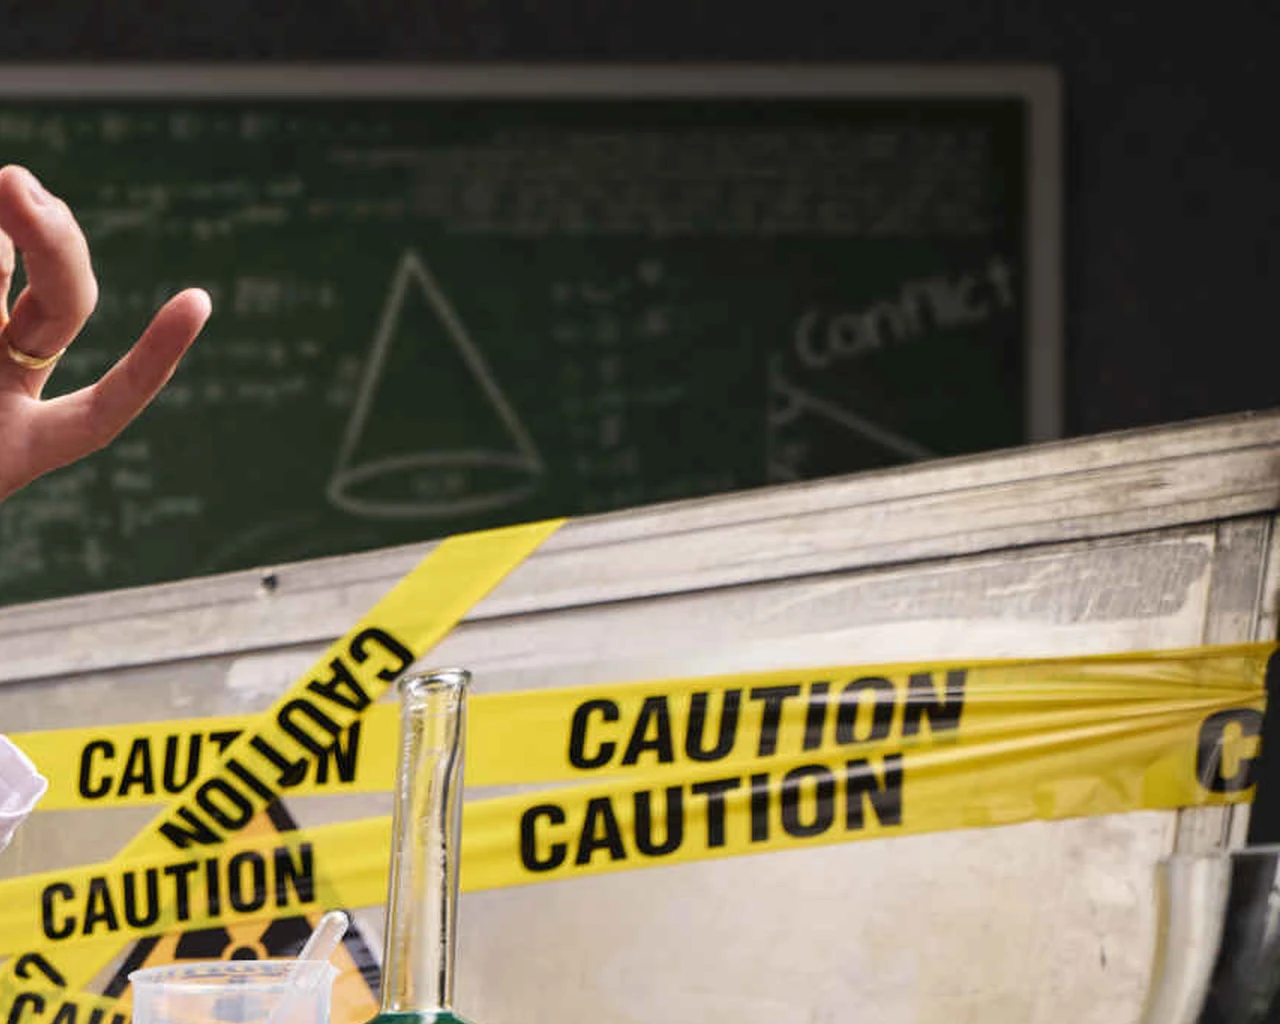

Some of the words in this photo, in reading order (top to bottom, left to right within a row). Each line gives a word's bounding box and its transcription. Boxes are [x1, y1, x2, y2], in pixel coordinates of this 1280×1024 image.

[794, 254, 1015, 370] Conflict
[158, 627, 416, 849] CAUTION
[568, 668, 968, 770] CAUTION
[518, 754, 905, 872] CAUTION
[41, 842, 316, 941] CAUTION
